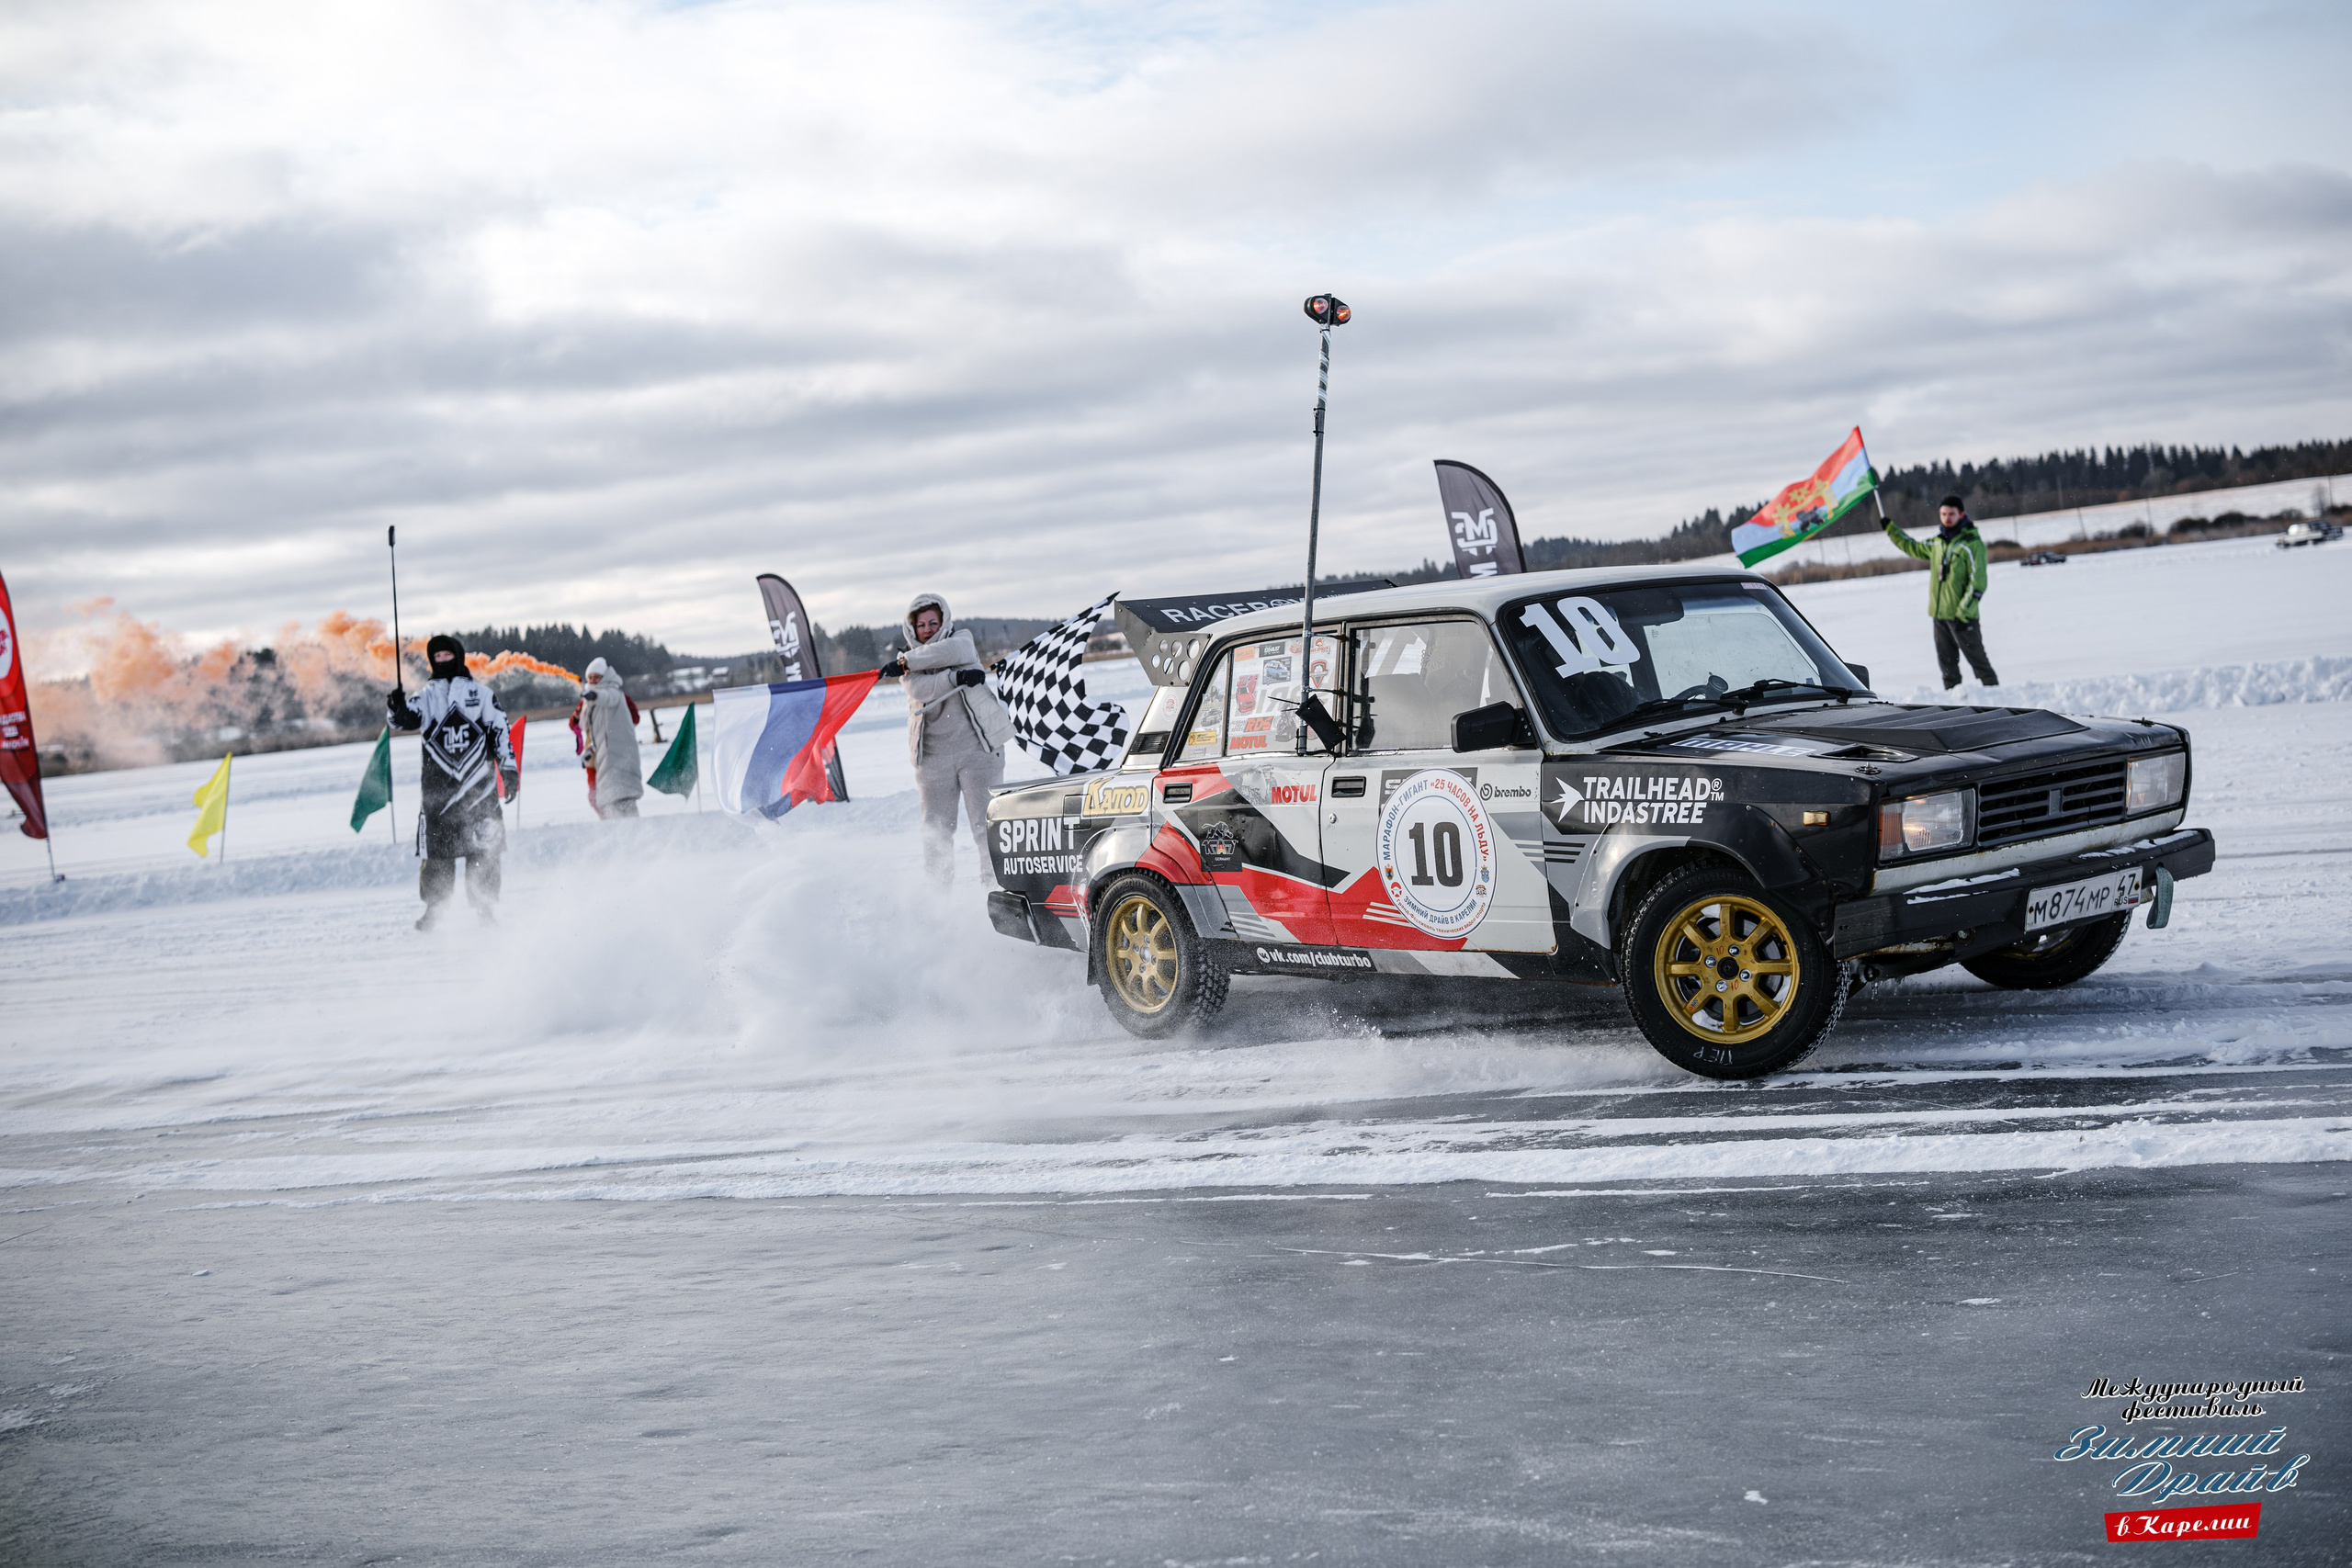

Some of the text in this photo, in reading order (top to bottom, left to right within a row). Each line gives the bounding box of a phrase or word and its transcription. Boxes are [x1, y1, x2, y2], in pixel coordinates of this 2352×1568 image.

[1519, 596, 1641, 679] 10
[1245, 716, 1273, 732] RDS
[1229, 735, 1267, 750] MOTUL
[1082, 777, 1148, 817] KATOD
[1271, 784, 1317, 805] MOTUL
[1494, 785, 1532, 797] brembo
[1382, 779, 1429, 861] МАРАФОН-ГИГАНТ
[1447, 781, 1471, 807] ЧАСОВ
[1467, 805, 1479, 823] НА
[1584, 801, 1707, 823] INDASTREE
[999, 816, 1080, 853] SPRINT
[1004, 854, 1083, 874] AUTOSERVICE
[1408, 821, 1464, 887] 10
[2117, 874, 2136, 897] 47
[1403, 896, 1429, 919] ЗИМНИЙ
[1429, 915, 1449, 925] ДРАЙВ
[1455, 898, 1477, 923] КАРЕЛИИ
[2114, 896, 2128, 906] RUS
[1269, 949, 1372, 967] vk.com/clubturbo
